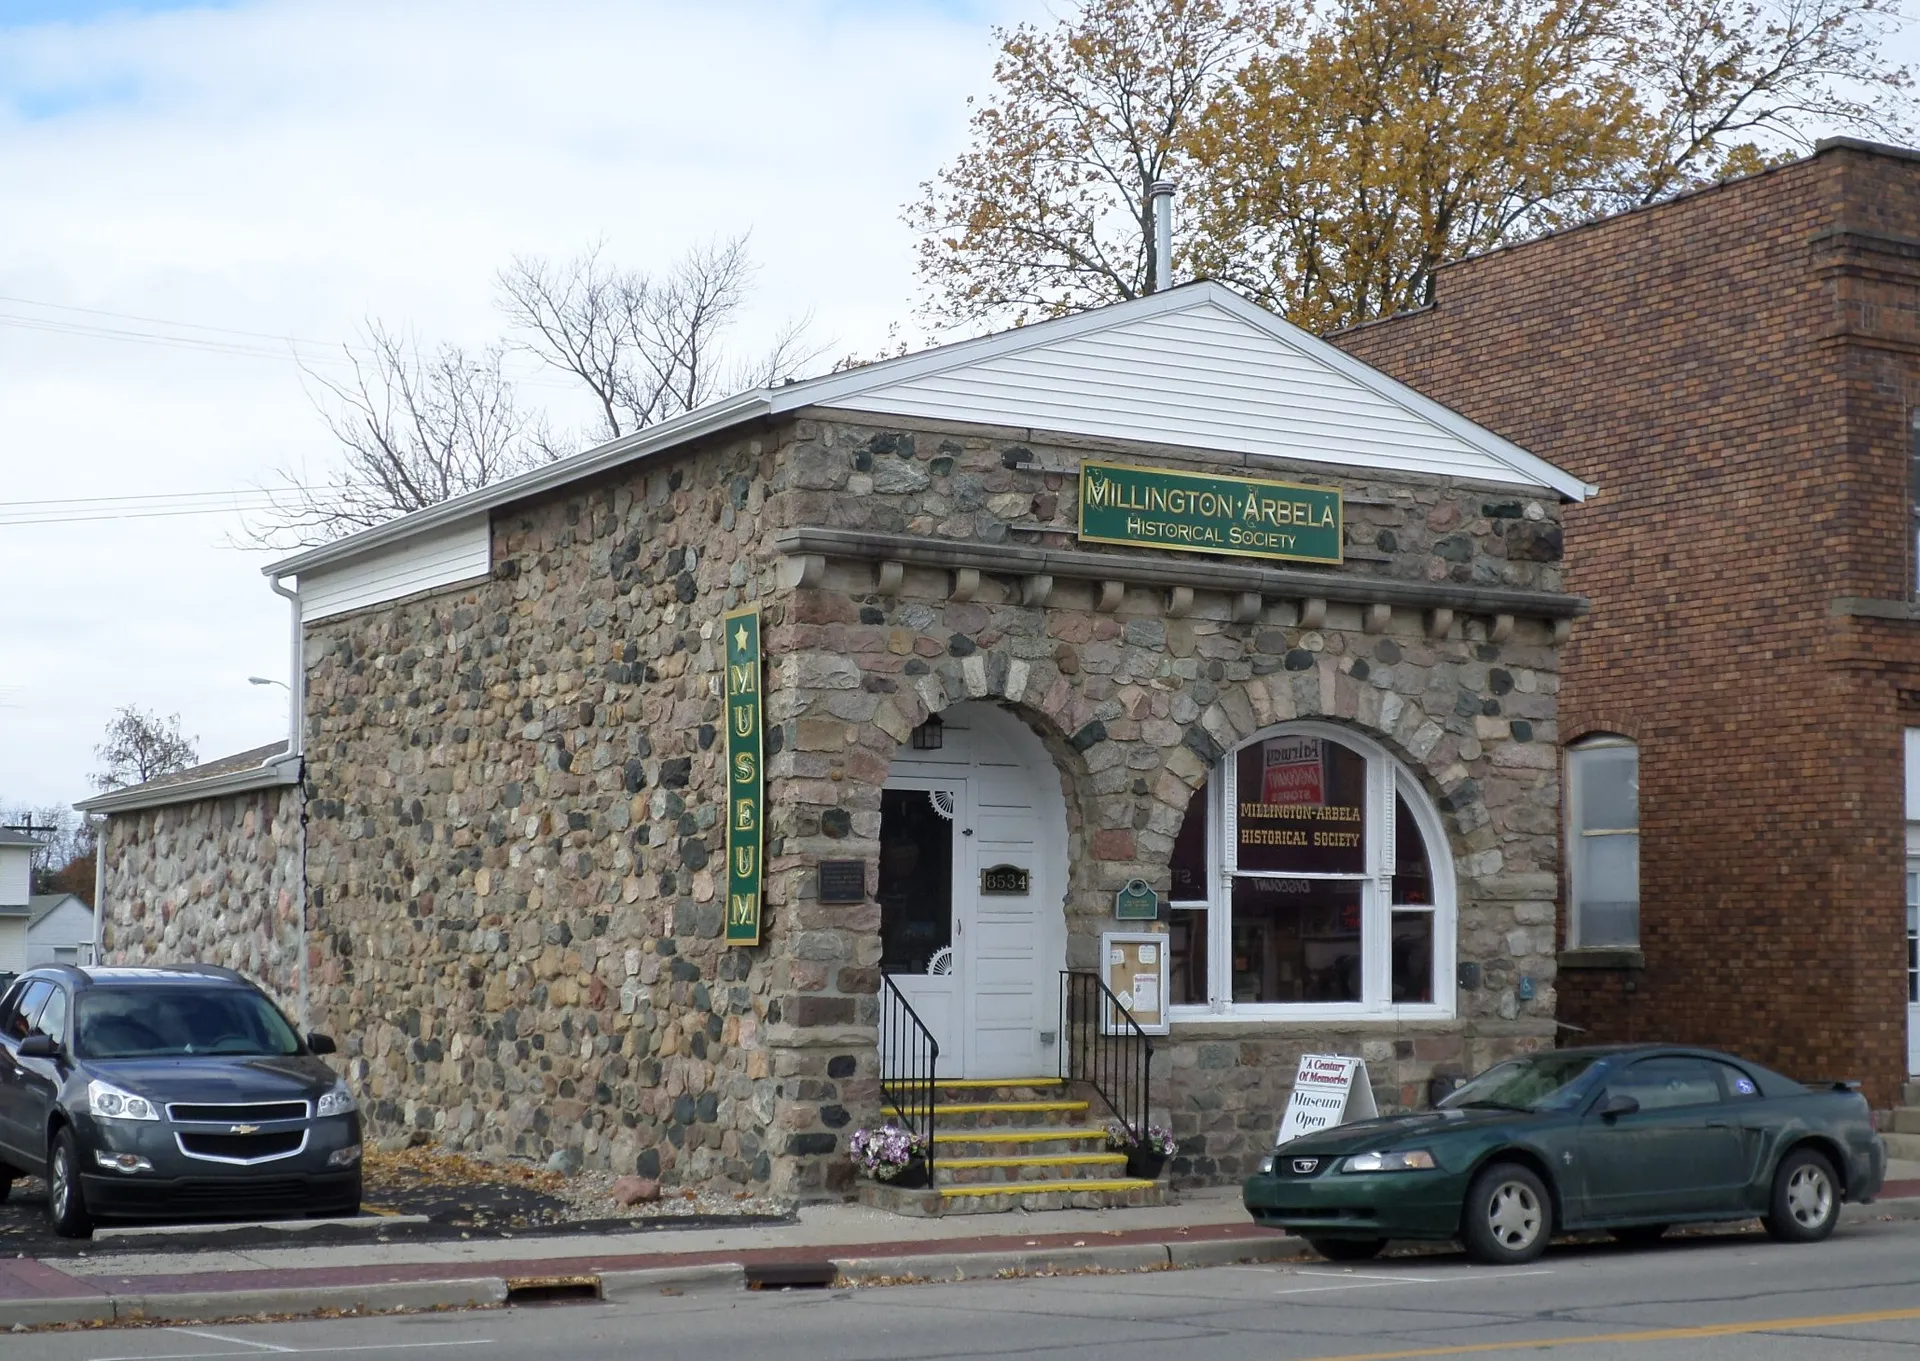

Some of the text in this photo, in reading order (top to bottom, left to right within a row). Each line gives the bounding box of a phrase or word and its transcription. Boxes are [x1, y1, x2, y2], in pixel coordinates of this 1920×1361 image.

[1127, 516, 1296, 549] HISTORICAL SOCIETY
[730, 661, 755, 926] MUSEUM
[1241, 803, 1361, 821] MILLINGTON-ARBELA
[1241, 829, 1360, 847] HISTORICAL SOCIETY
[987, 874, 1027, 889] 8534
[1299, 1071, 1309, 1082] Of
[1306, 1060, 1346, 1076] A Century
[1294, 1092, 1341, 1109] Museum
[1296, 1111, 1326, 1129] Open
